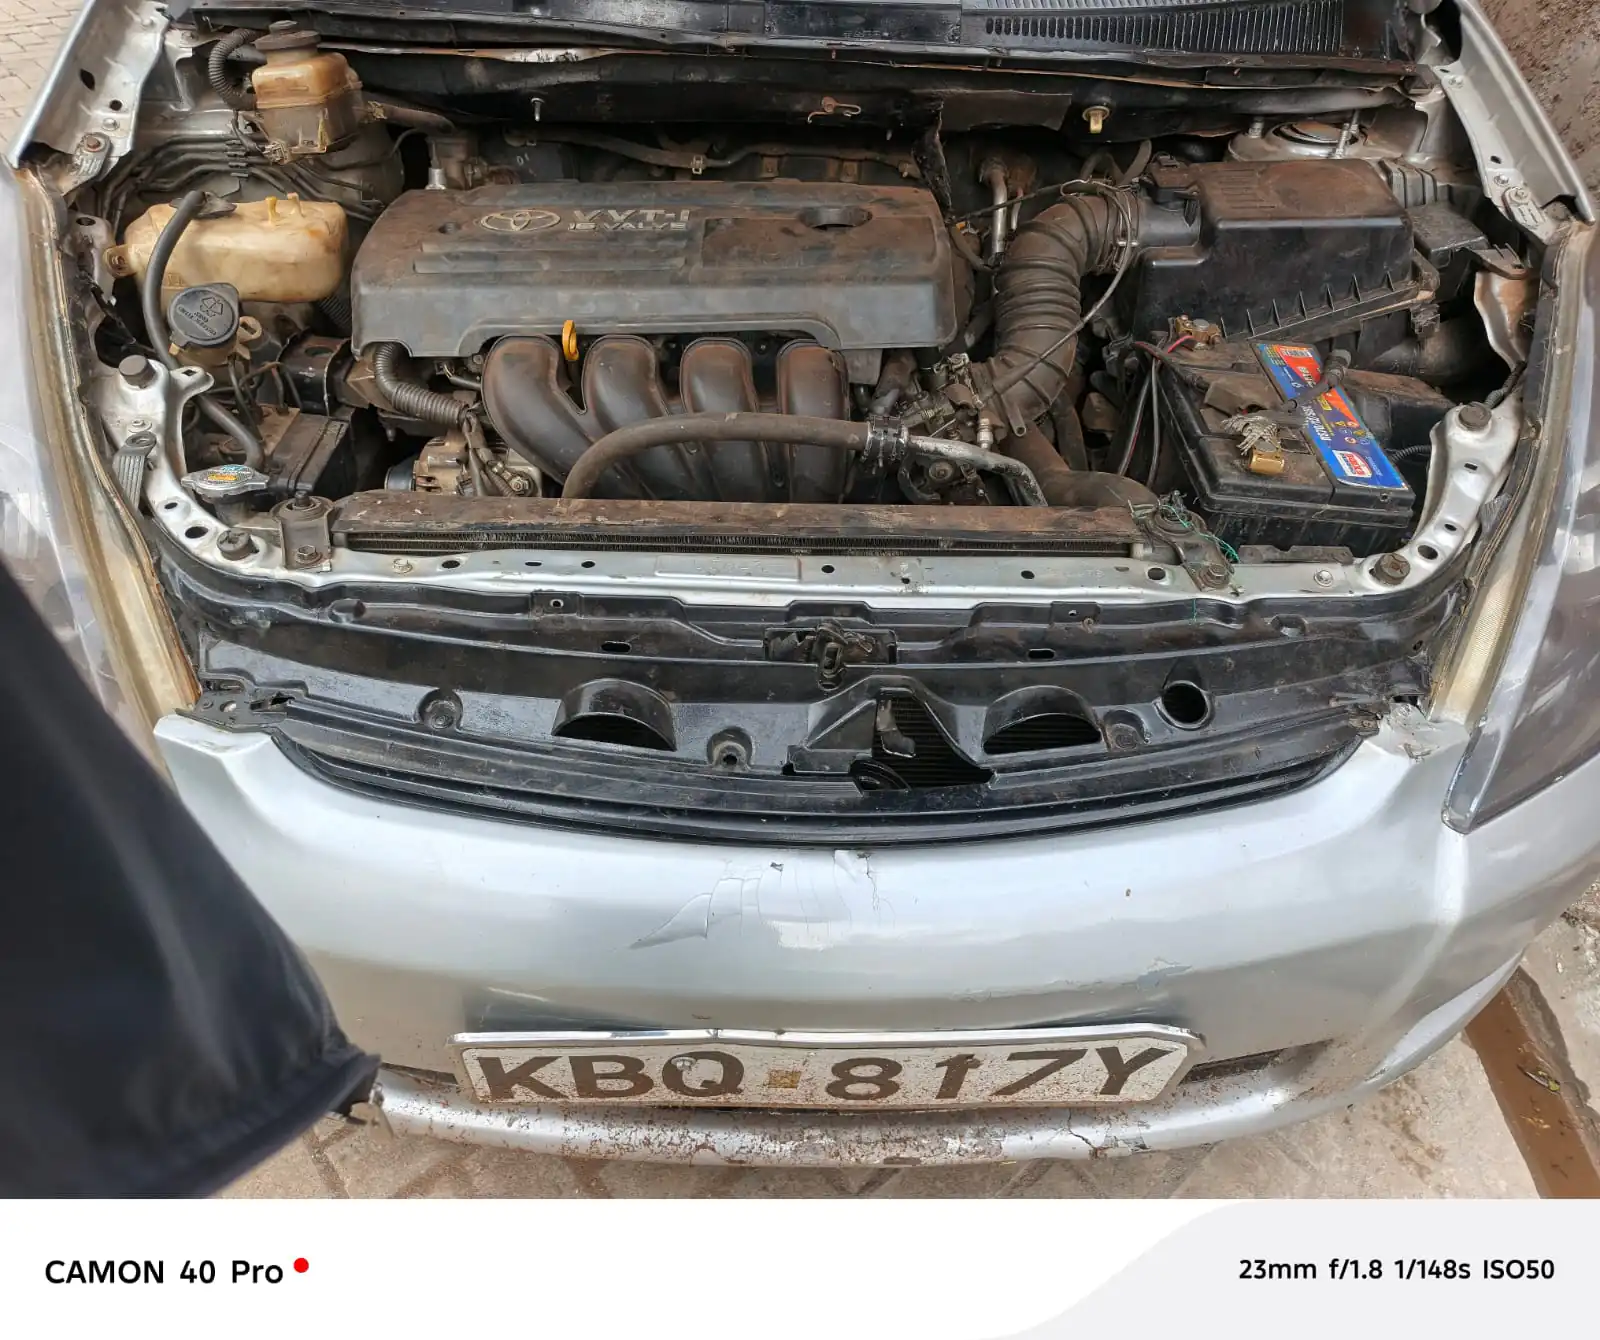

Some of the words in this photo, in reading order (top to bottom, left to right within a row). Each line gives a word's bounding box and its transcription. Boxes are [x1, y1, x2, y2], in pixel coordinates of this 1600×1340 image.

[603, 222, 687, 231] VALVE
[477, 1050, 744, 1099] KBQ
[824, 1046, 1170, 1101] 817Y
